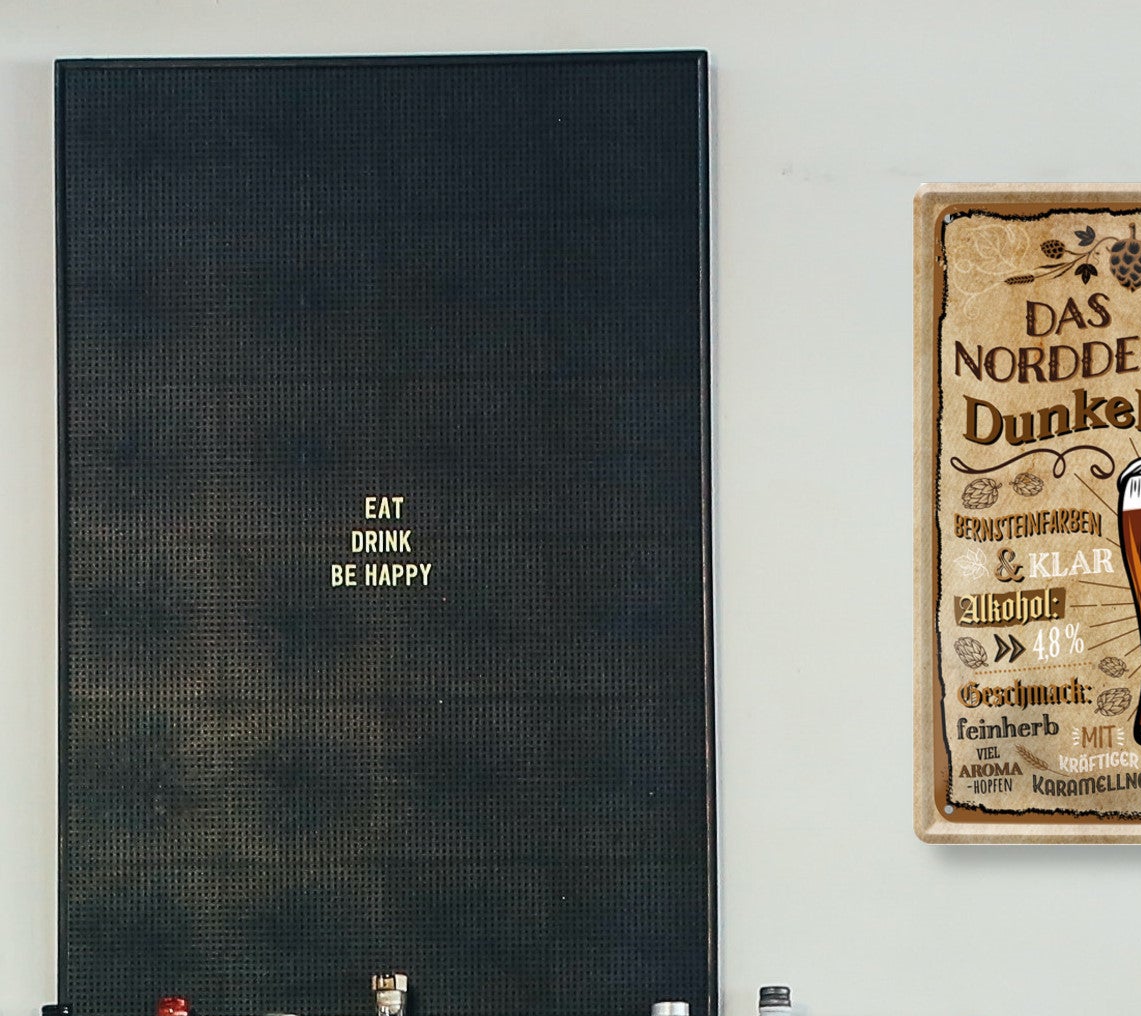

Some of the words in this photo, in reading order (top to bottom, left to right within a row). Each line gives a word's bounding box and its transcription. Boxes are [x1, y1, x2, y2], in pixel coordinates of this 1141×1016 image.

[1025, 292, 1112, 338] DAS
[365, 496, 404, 519] EAT
[954, 508, 1102, 543] BERNSTEINFARBEN
[351, 529, 412, 553] DRINK
[331, 563, 358, 587] BE
[365, 563, 432, 587] HAPPY
[994, 547, 1025, 583] &
[1028, 548, 1115, 578] KLAR
[958, 589, 1060, 626] Alkohol:
[957, 676, 1093, 711] Geschmack:
[957, 713, 1060, 741] feinherb
[1081, 724, 1116, 749] MIT
[976, 746, 1001, 761] VIEL
[1058, 751, 1140, 774] KRÄFTIGER
[958, 762, 1024, 778] AROMA
